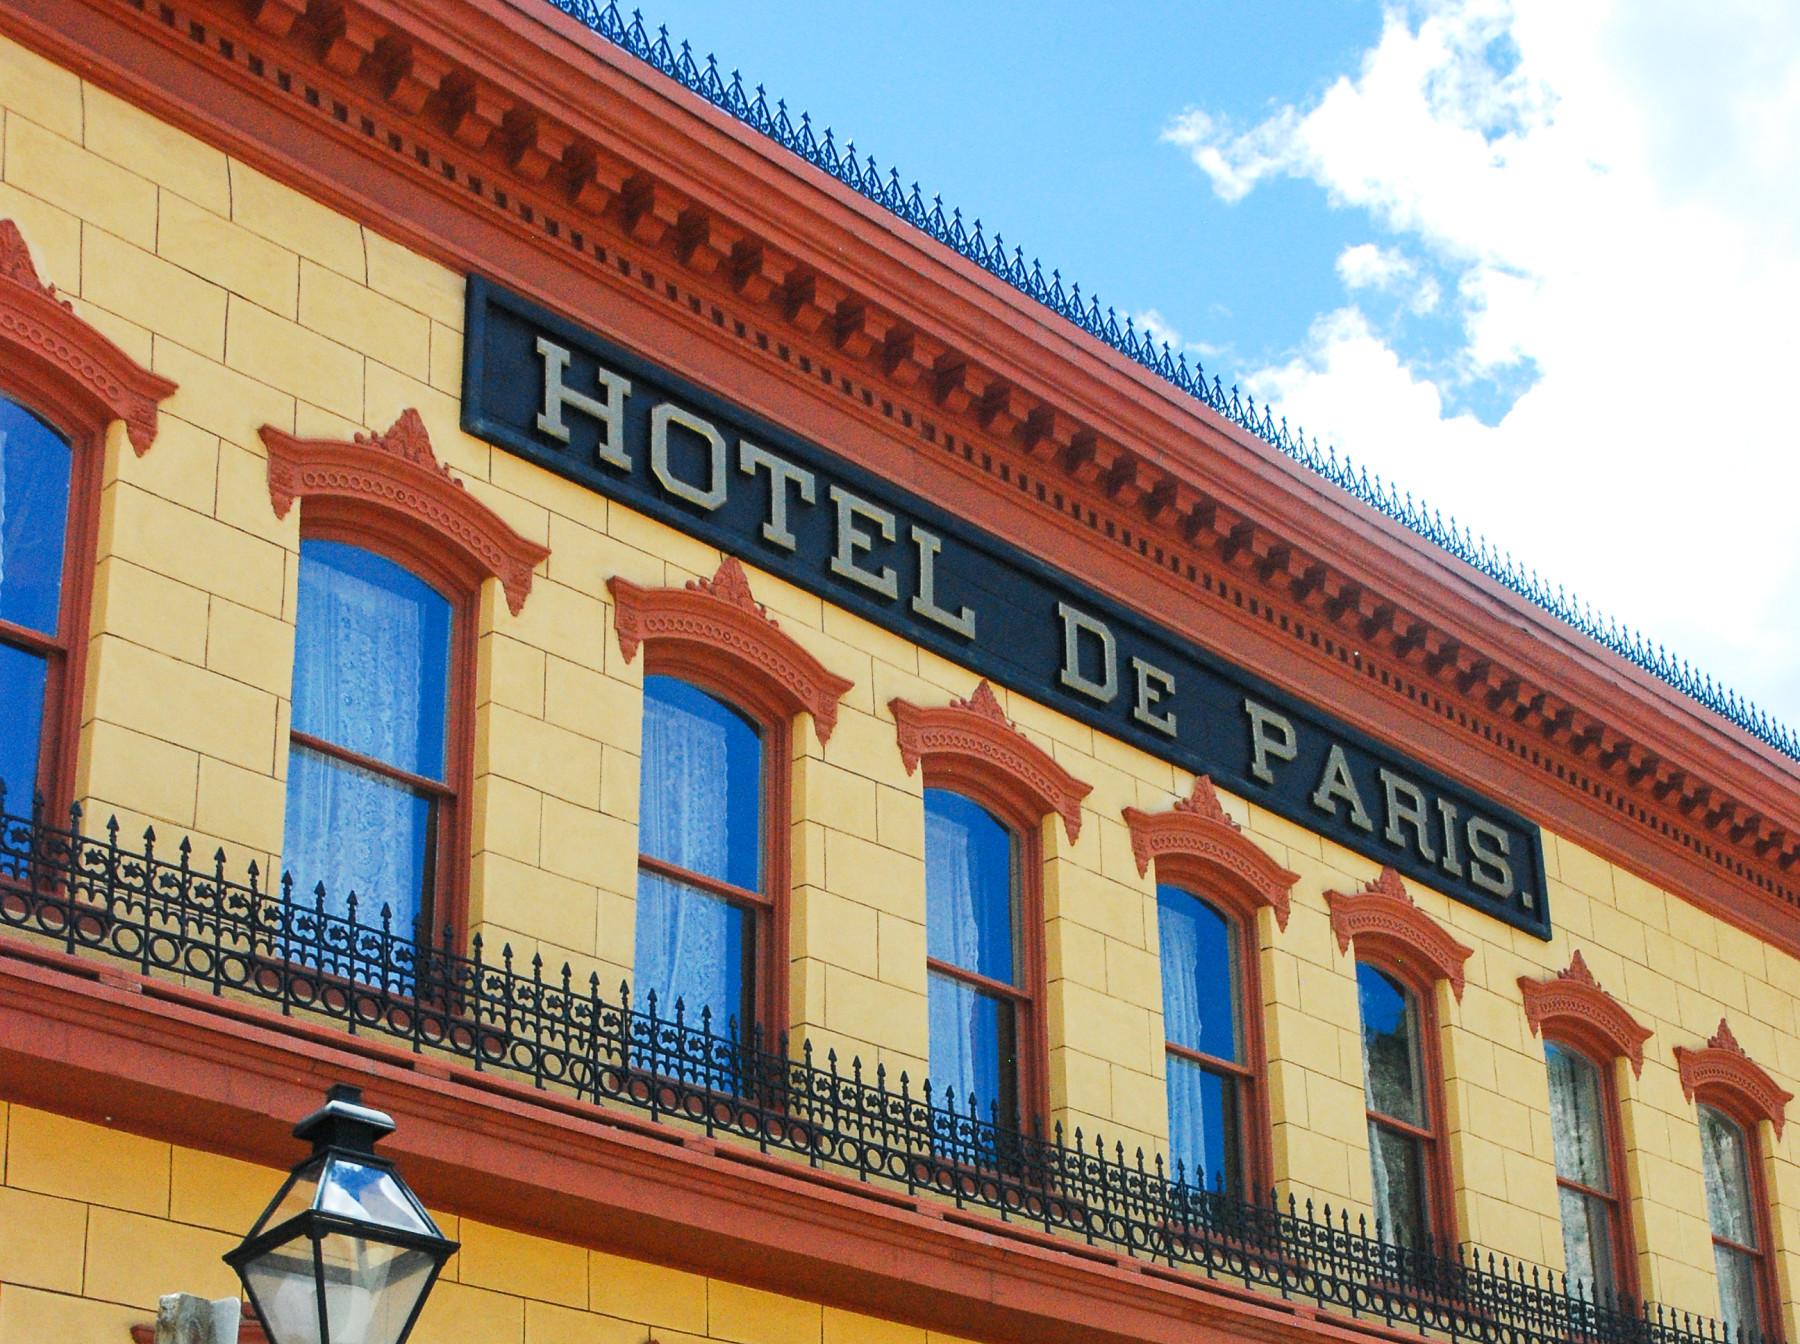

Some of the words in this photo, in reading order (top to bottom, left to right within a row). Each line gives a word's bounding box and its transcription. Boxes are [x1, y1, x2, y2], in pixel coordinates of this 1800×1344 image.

[536, 336, 976, 640] HOTEL
[1058, 601, 1177, 737] DE
[1245, 698, 1534, 909] PARIS.
